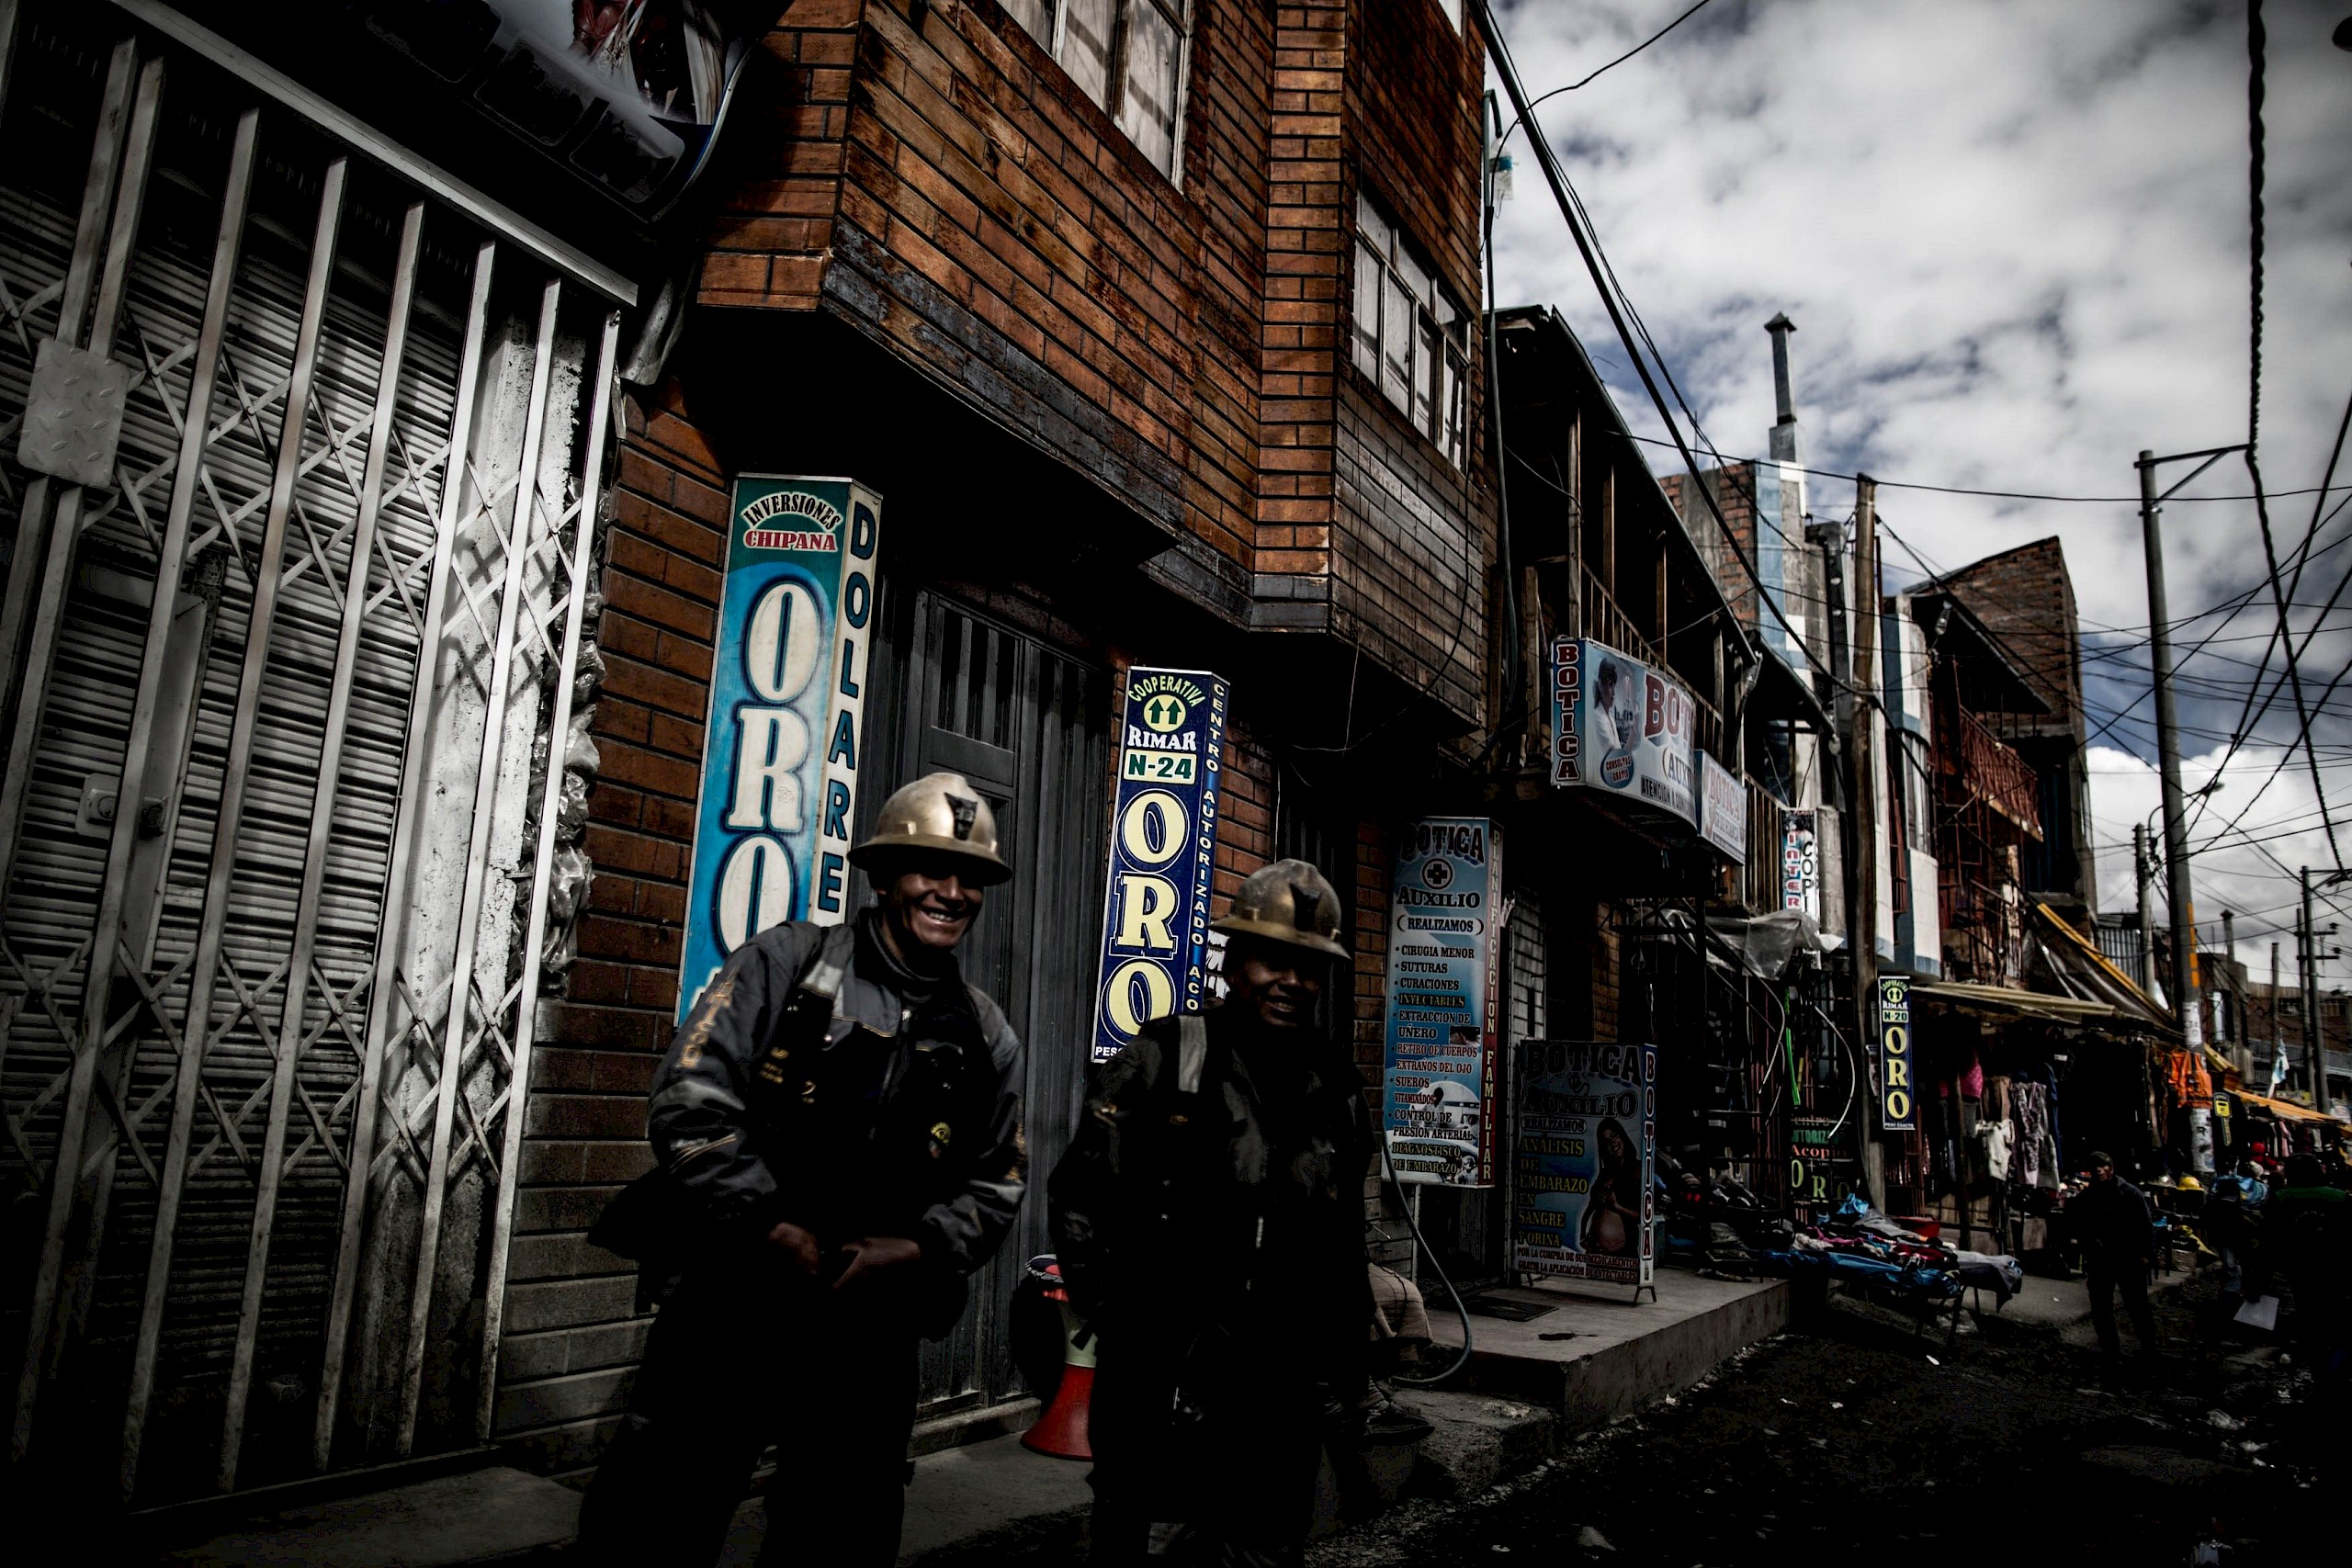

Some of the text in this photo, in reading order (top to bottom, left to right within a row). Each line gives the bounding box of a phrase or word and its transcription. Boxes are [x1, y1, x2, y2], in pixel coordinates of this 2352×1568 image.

[743, 494, 841, 530] INVERSIONES
[745, 530, 837, 551] CHIPANA
[1128, 675, 1206, 707] COOPERATIVA
[1555, 645, 1580, 781] BOTICA
[1205, 682, 1225, 773] CENTRO
[1126, 724, 1197, 751] RIMAR
[717, 580, 823, 953] ORO
[1128, 753, 1193, 779] N-24
[1191, 789, 1216, 945] AUTORIZADO
[1397, 886, 1480, 908] AUXILIO
[1104, 790, 1189, 1040] ORO
[1408, 917, 1474, 932] REALIZAMOS
[1487, 829, 1501, 1034] PLANIFICACION
[1401, 945, 1475, 959] CIRUGIA MENOR
[1400, 961, 1448, 974] SUTURAS
[1400, 977, 1460, 991] CURACIONES
[1399, 994, 1464, 1008] INYECTABLES
[1883, 999, 1908, 1010] RIMAR
[1399, 1010, 1470, 1024] EXTRACCION DE
[1884, 1011, 1907, 1021] N-20
[1398, 1023, 1437, 1039] UÑERO
[1095, 1046, 1122, 1056] PES
[1397, 1043, 1477, 1058] RETIRO DE CUERPOS
[1396, 1057, 1472, 1074] EXTRAÑOS DEL OJO
[1525, 1043, 1642, 1087] BOTICA
[1884, 1026, 1911, 1121] ORO
[1396, 1076, 1430, 1089] SUEROS
[1395, 1109, 1452, 1123] CONTROL DE
[1483, 1050, 1496, 1180] FAMILIAR
[1393, 1126, 1472, 1140] PRESION ARTERIAL
[1643, 1051, 1655, 1258] BOTICA
[1393, 1158, 1457, 1174] DE EMBARAZO
[1520, 1174, 1588, 1193] EMBARAZO
[1519, 1192, 1535, 1205] EN
[1519, 1210, 1565, 1227] SANGRE
[1528, 1232, 1560, 1247] ORINA
[1518, 1247, 1530, 1258] POR
[1532, 1248, 1538, 1258] LA
[1540, 1250, 1564, 1261] COMPRA
[1566, 1253, 1574, 1261] DE
[1588, 1254, 1638, 1269] MEDICAMENTOS
[1541, 1262, 1547, 1271] LA
